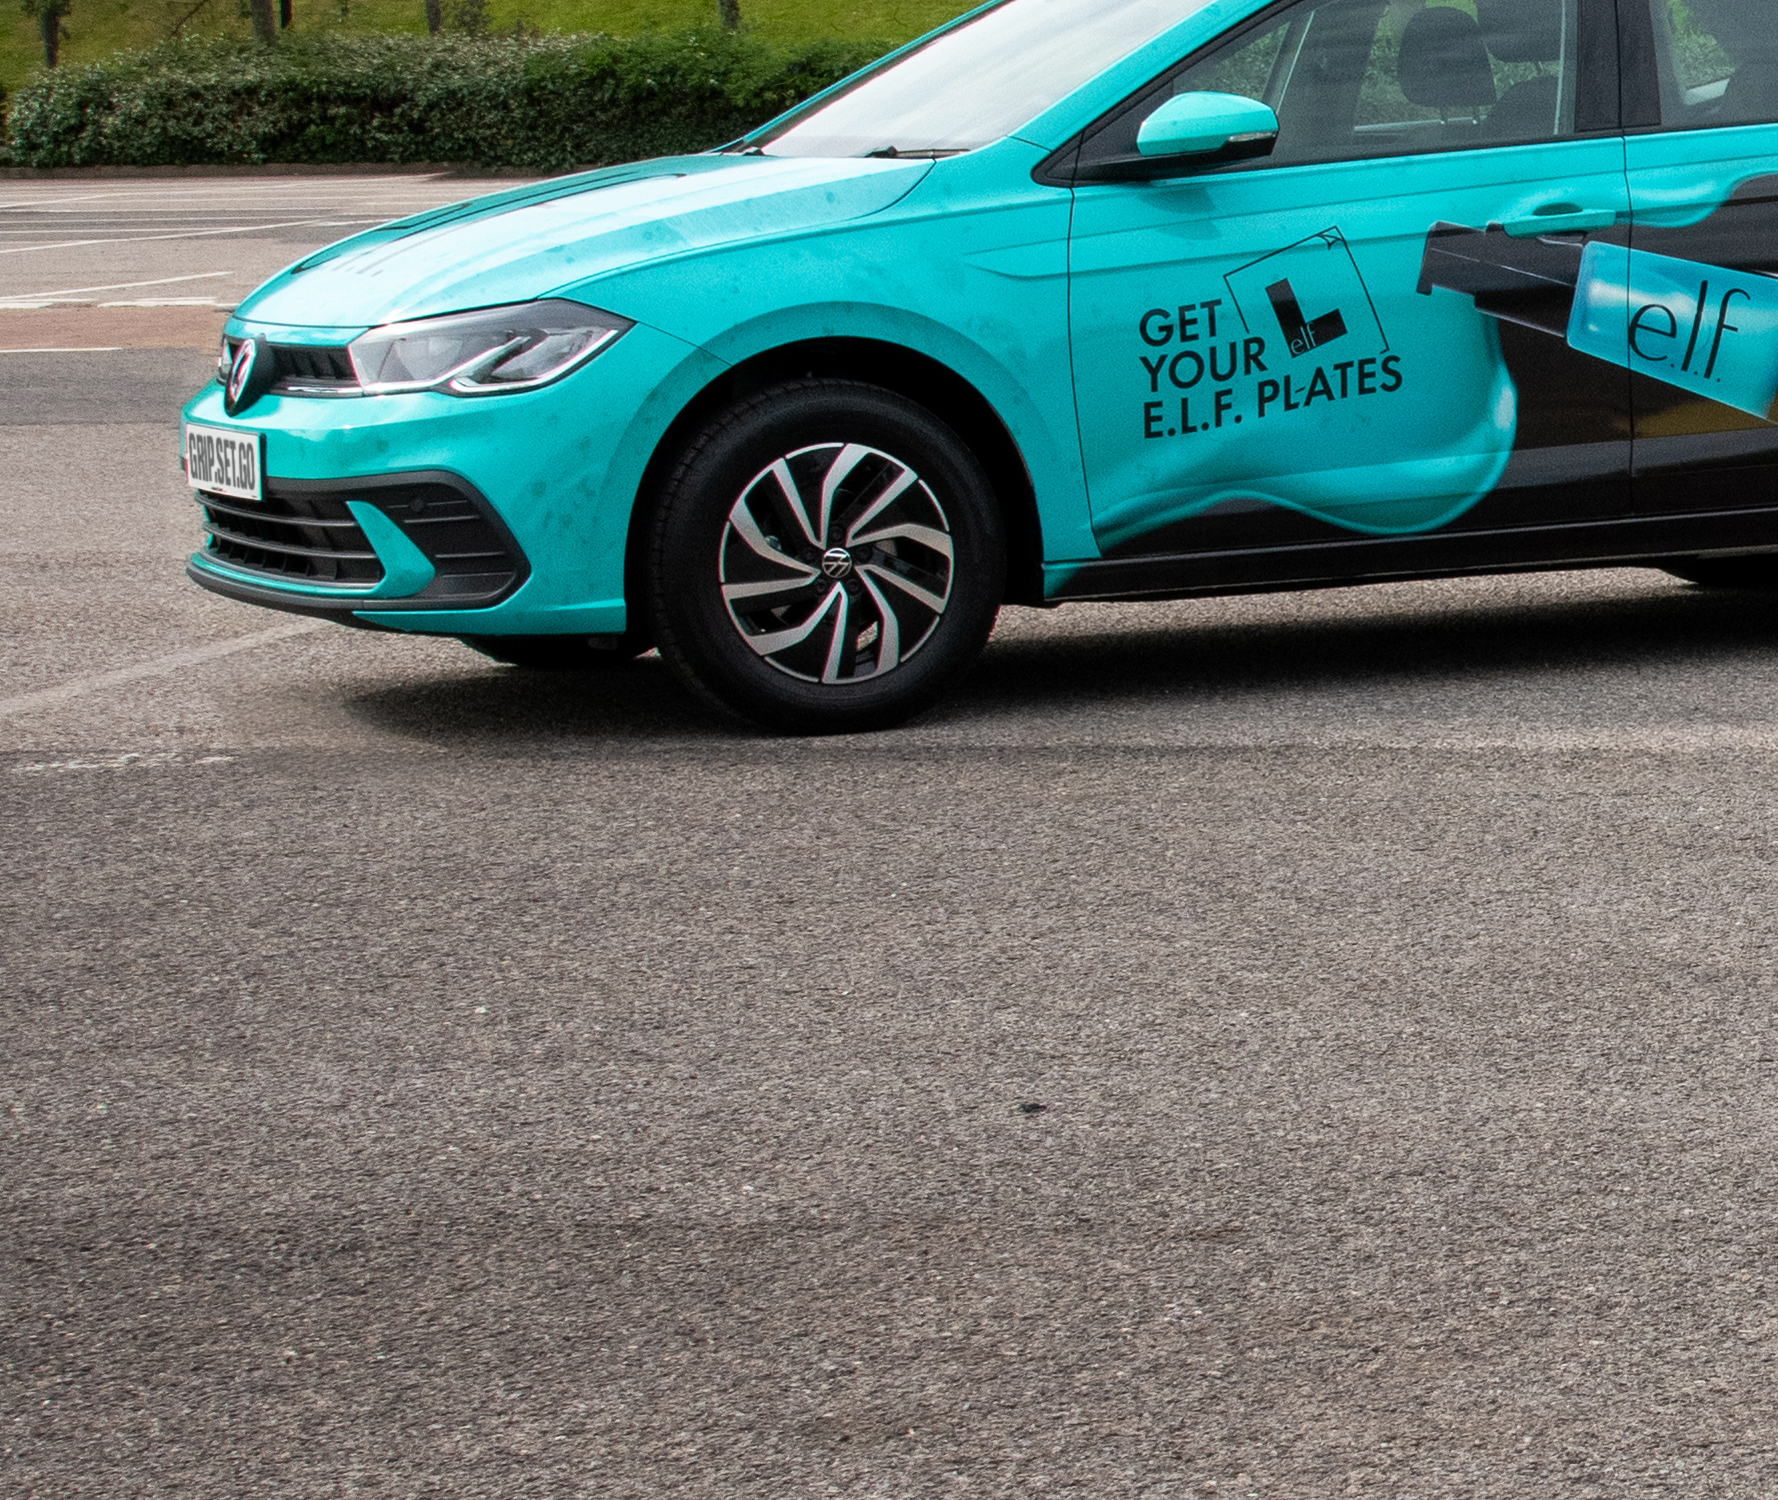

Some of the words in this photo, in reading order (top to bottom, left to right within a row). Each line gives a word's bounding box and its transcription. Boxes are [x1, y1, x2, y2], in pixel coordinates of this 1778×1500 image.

[1139, 298, 1222, 347] GET
[1138, 336, 1269, 393] YOUR
[1143, 388, 1244, 439] E.L.F.
[1257, 355, 1403, 419] PLATES
[188, 432, 256, 491] GRIP.SET.GO
